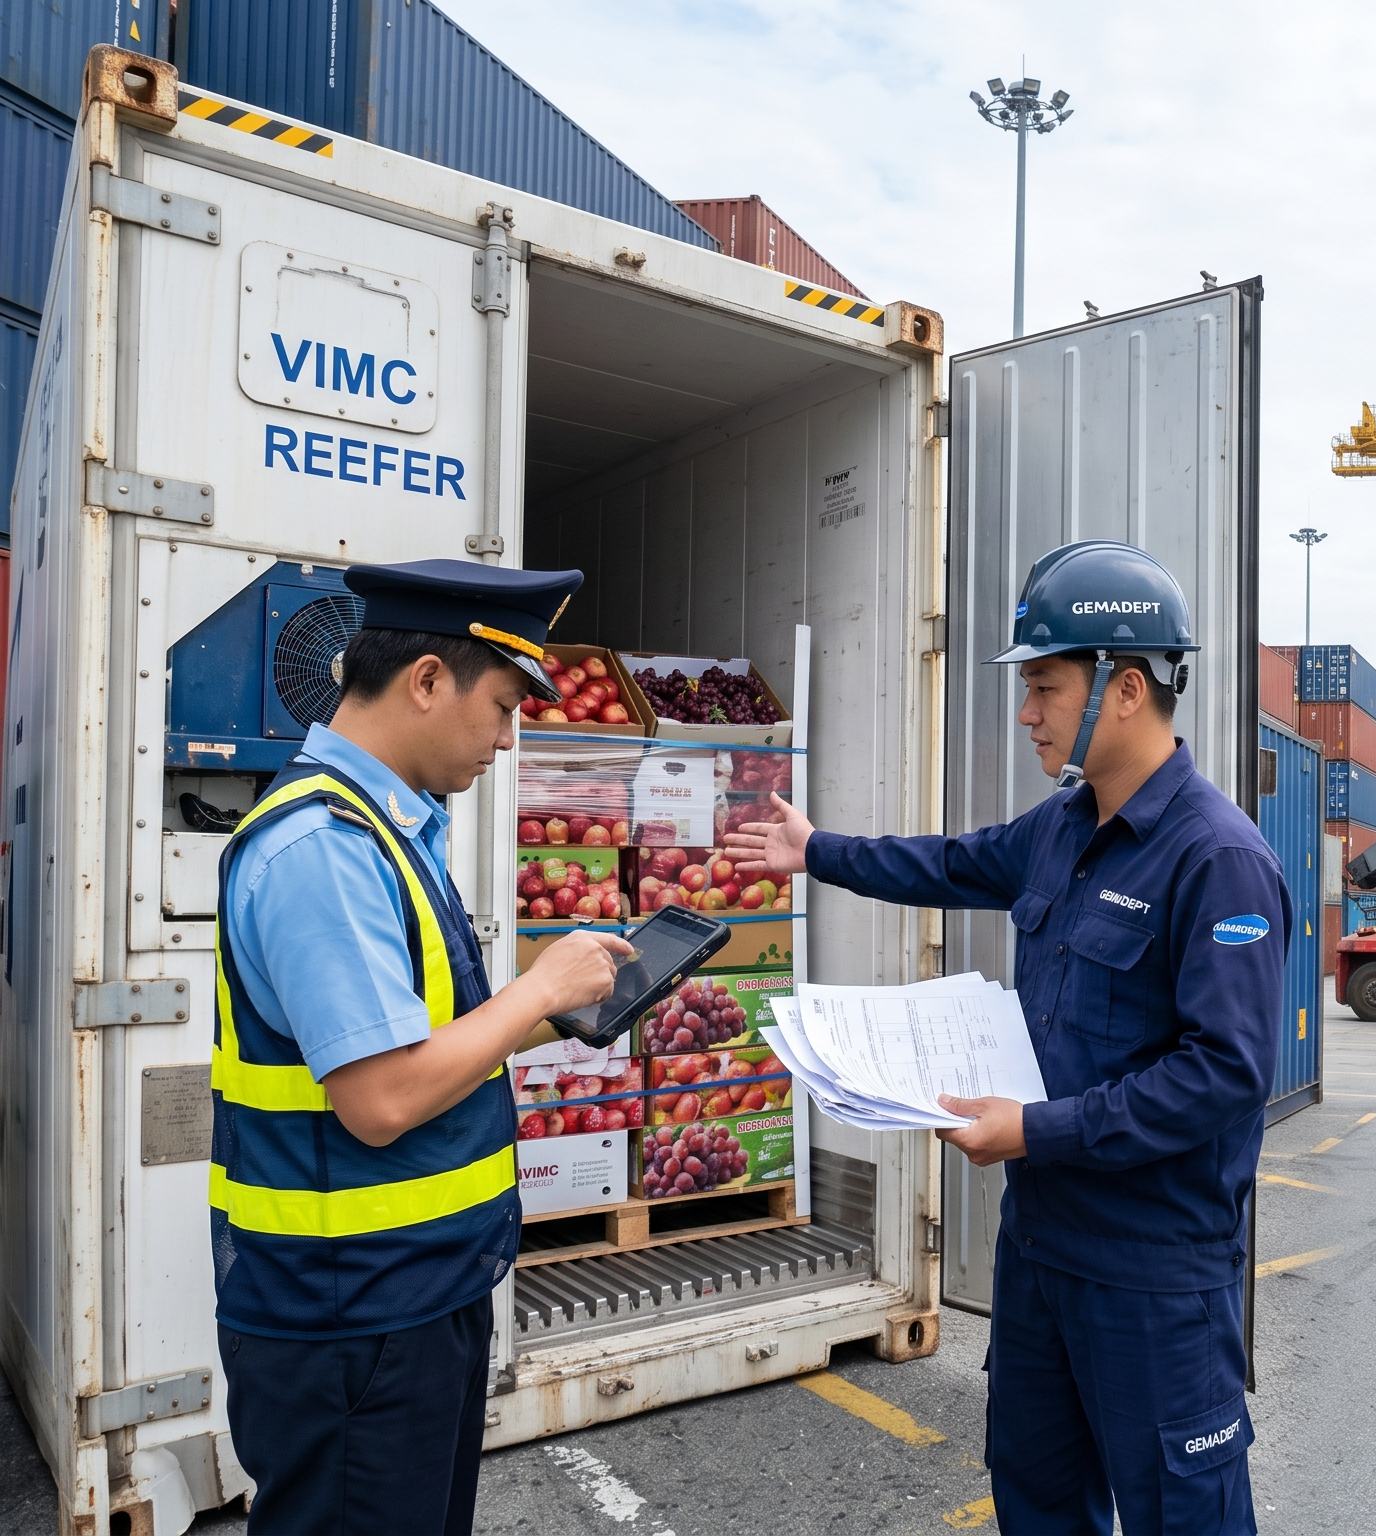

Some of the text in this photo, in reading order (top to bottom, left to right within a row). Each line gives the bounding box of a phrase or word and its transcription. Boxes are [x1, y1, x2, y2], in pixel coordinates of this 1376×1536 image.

[270, 332, 417, 405] VIMC
[265, 424, 467, 500] REEFER
[1072, 601, 1160, 614] GEMADEPT
[1185, 1418, 1241, 1454] GEMADEPT
